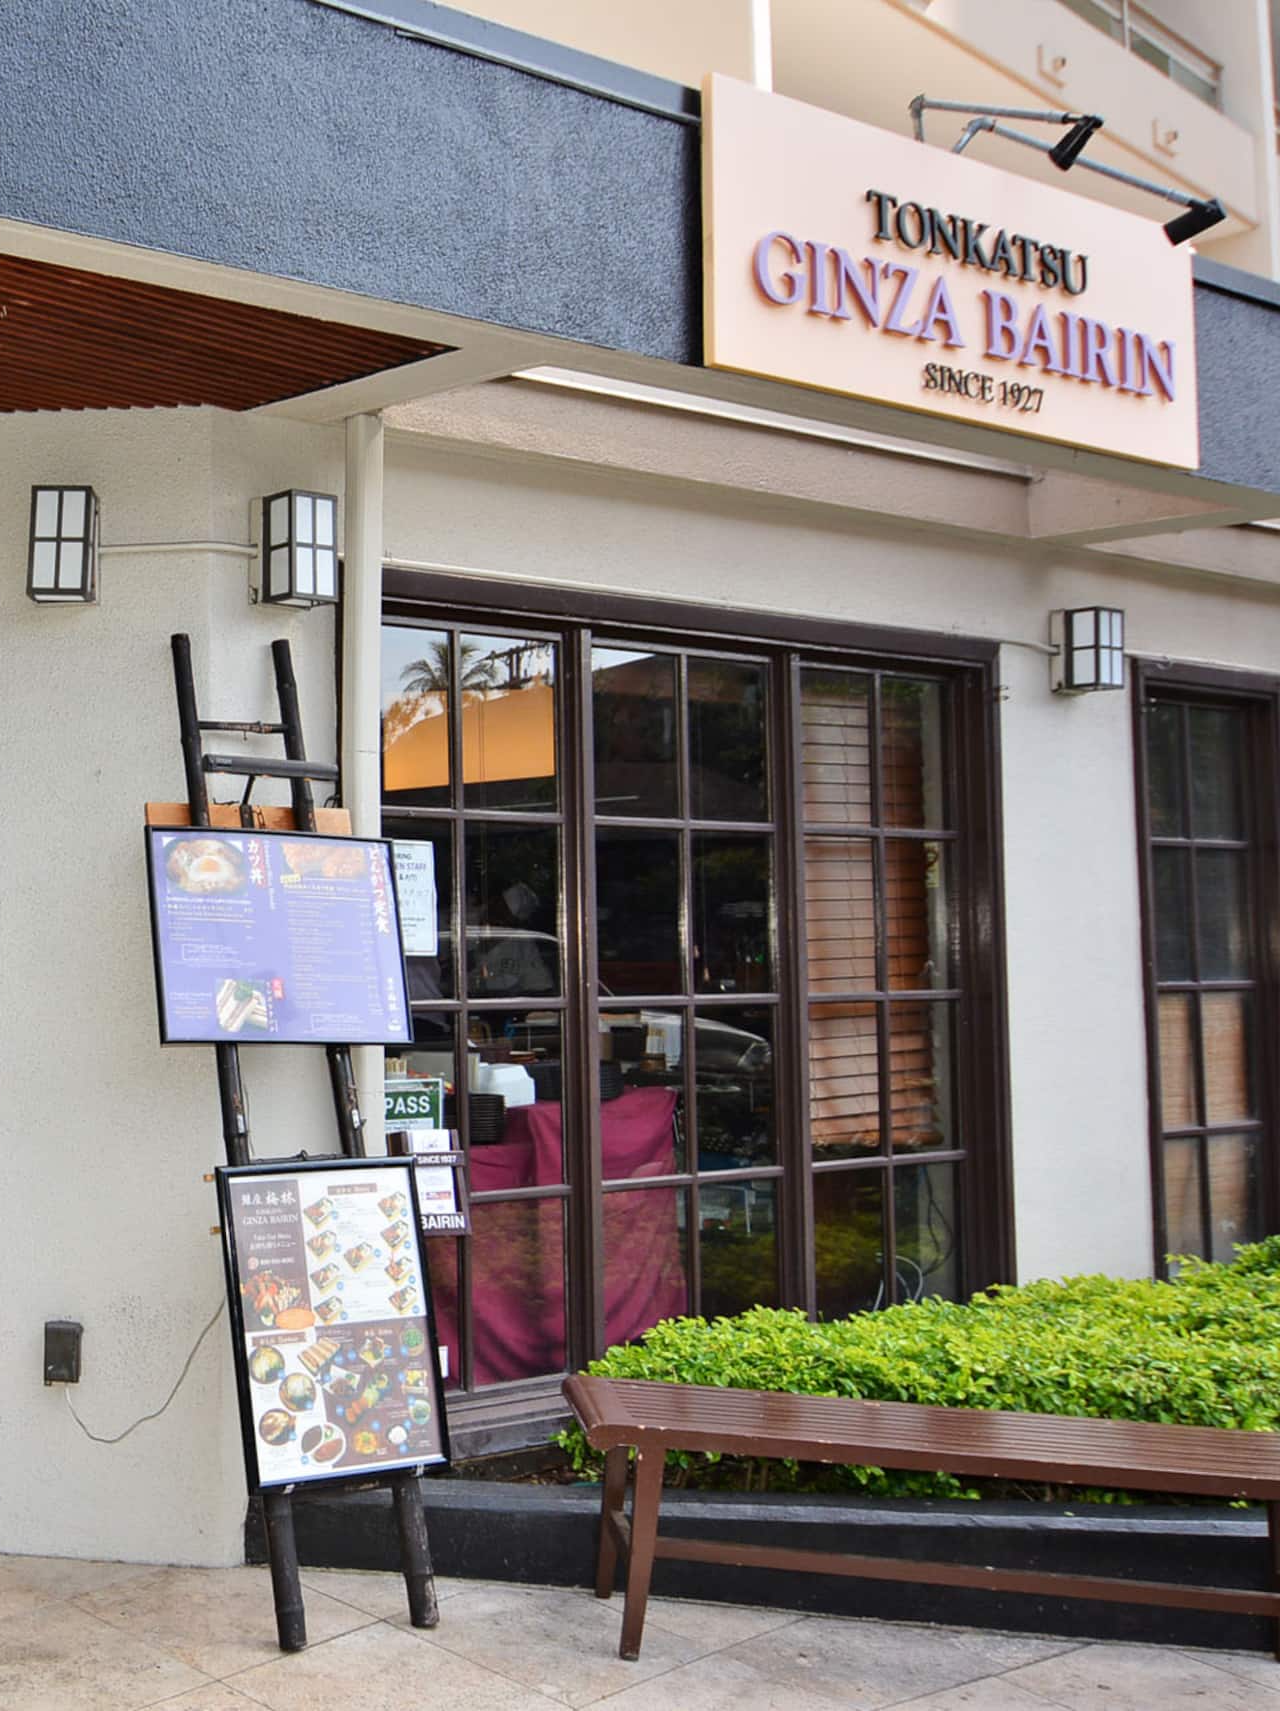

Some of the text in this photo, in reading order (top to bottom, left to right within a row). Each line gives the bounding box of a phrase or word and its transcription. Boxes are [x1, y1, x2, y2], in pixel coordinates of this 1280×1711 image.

[866, 188, 1088, 295] TONKATSU
[753, 230, 1177, 404] GINZA BAIRIN
[923, 362, 1045, 413] SINCE 1927
[384, 1096, 430, 1115] PASS
